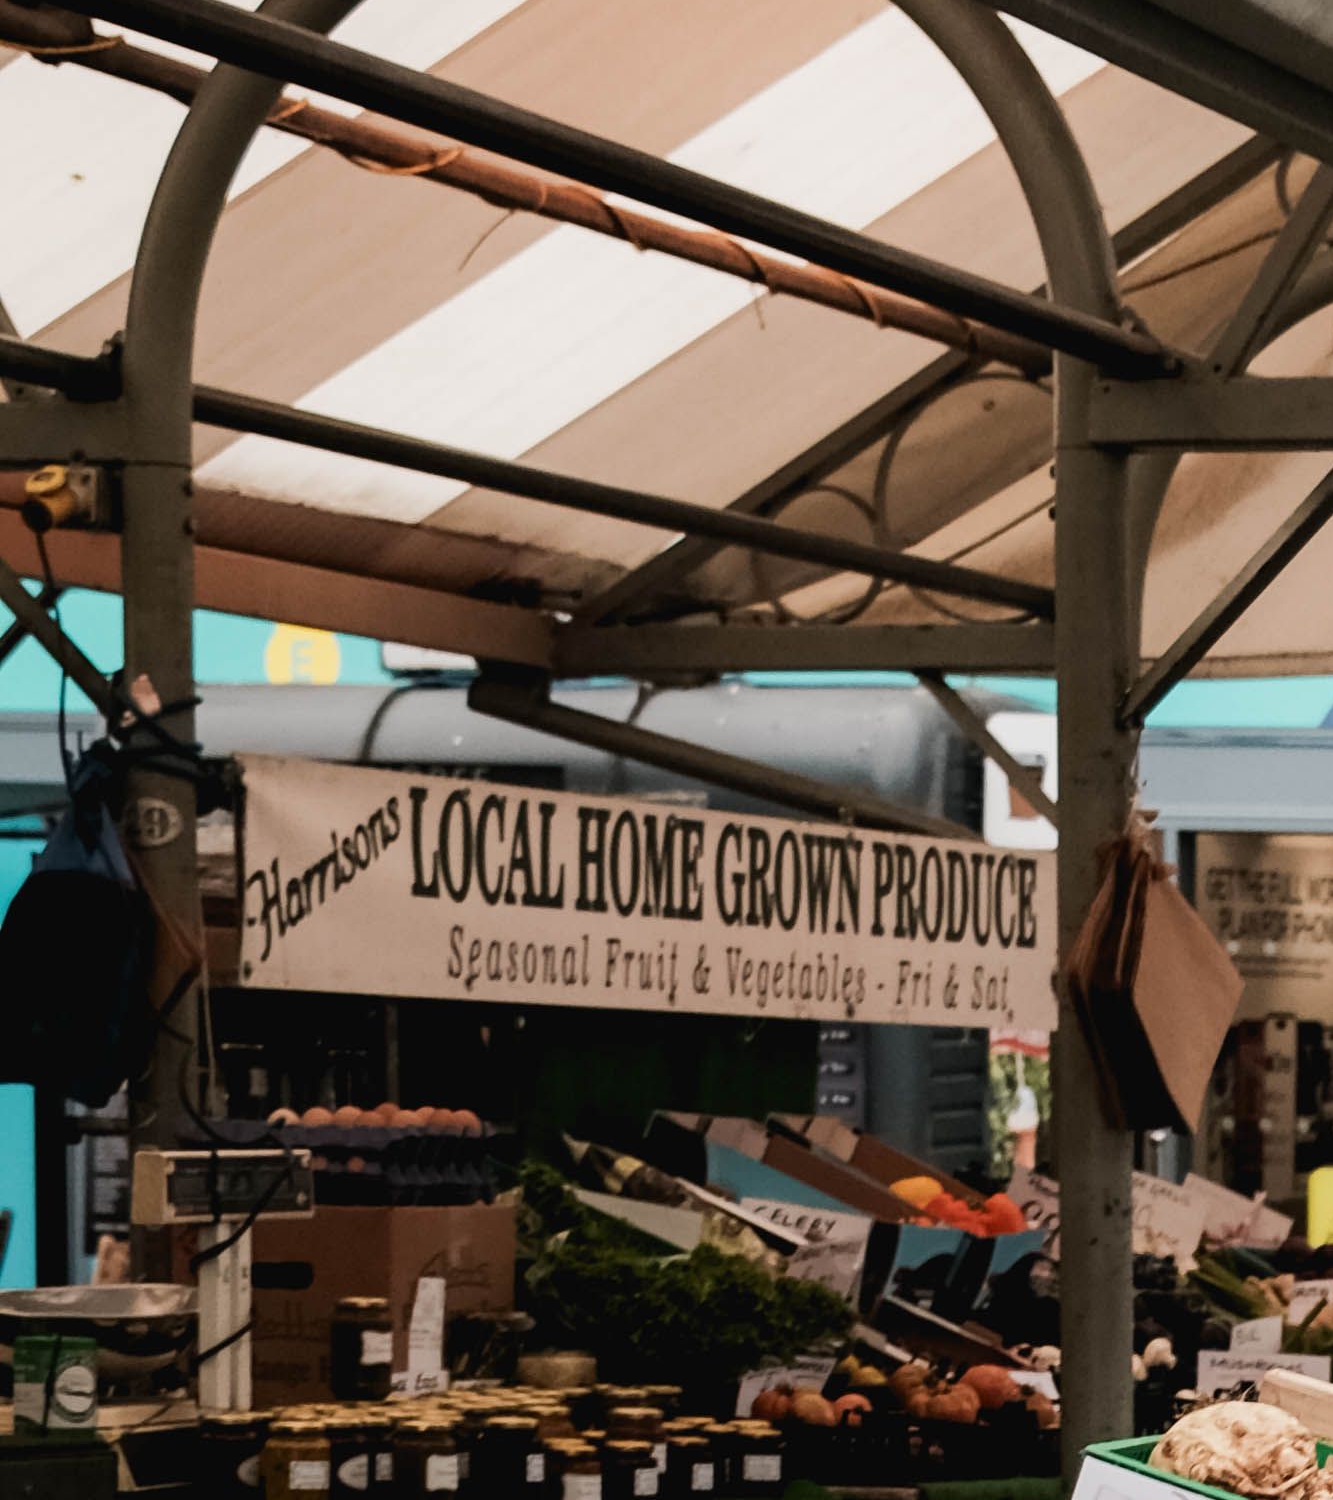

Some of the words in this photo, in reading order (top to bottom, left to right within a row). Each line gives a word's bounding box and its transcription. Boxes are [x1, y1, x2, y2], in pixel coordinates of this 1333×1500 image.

[246, 796, 401, 962] Harrisons
[408, 786, 565, 909] LOCAL
[575, 806, 705, 921] HOME
[715, 820, 863, 936] GROWN
[870, 841, 1037, 949] PRODUCE
[447, 924, 590, 987] Seasonal
[604, 937, 679, 993] Fruit
[691, 940, 711, 995] &
[725, 946, 867, 1008] Vegetables
[895, 959, 932, 1007] Fri
[943, 964, 959, 1010] &
